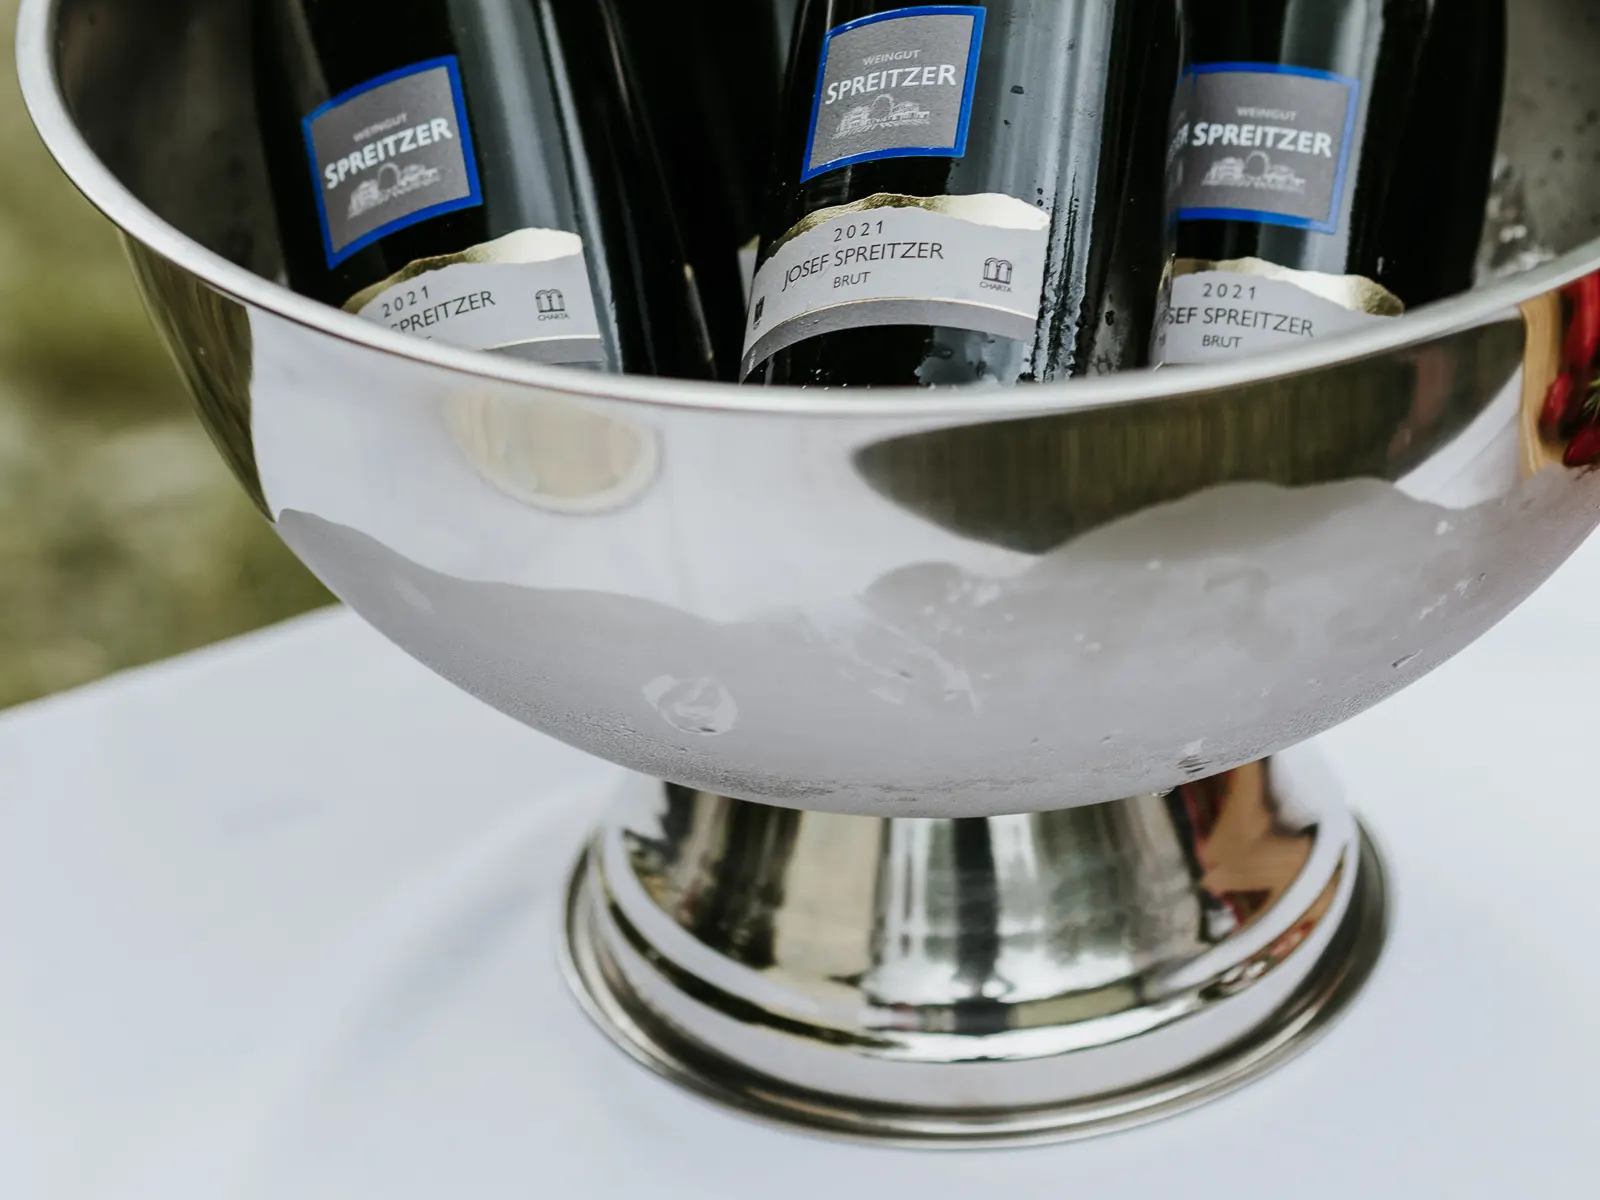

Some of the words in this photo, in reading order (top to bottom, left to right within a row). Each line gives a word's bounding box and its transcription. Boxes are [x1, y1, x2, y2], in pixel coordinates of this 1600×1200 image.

[861, 49, 921, 67] WEINGUT
[824, 64, 957, 105] SPREITZER
[1236, 106, 1297, 122] WEINGUT
[352, 112, 408, 143] WEINGUT
[1192, 122, 1333, 158] SPREITZER
[323, 117, 453, 189] SPREITZER
[833, 220, 885, 243] 2021
[781, 253, 829, 292] JOSEF
[834, 242, 945, 268] SPREITZER
[832, 271, 871, 289] BRUT
[979, 281, 1013, 293] CHARTA
[1202, 282, 1257, 300] 2021
[381, 284, 429, 318] 2021
[537, 312, 570, 321] CHARTA
[1167, 306, 1198, 325] SEF
[1202, 307, 1314, 337] SPREITZER
[1202, 334, 1242, 348] BRUT
